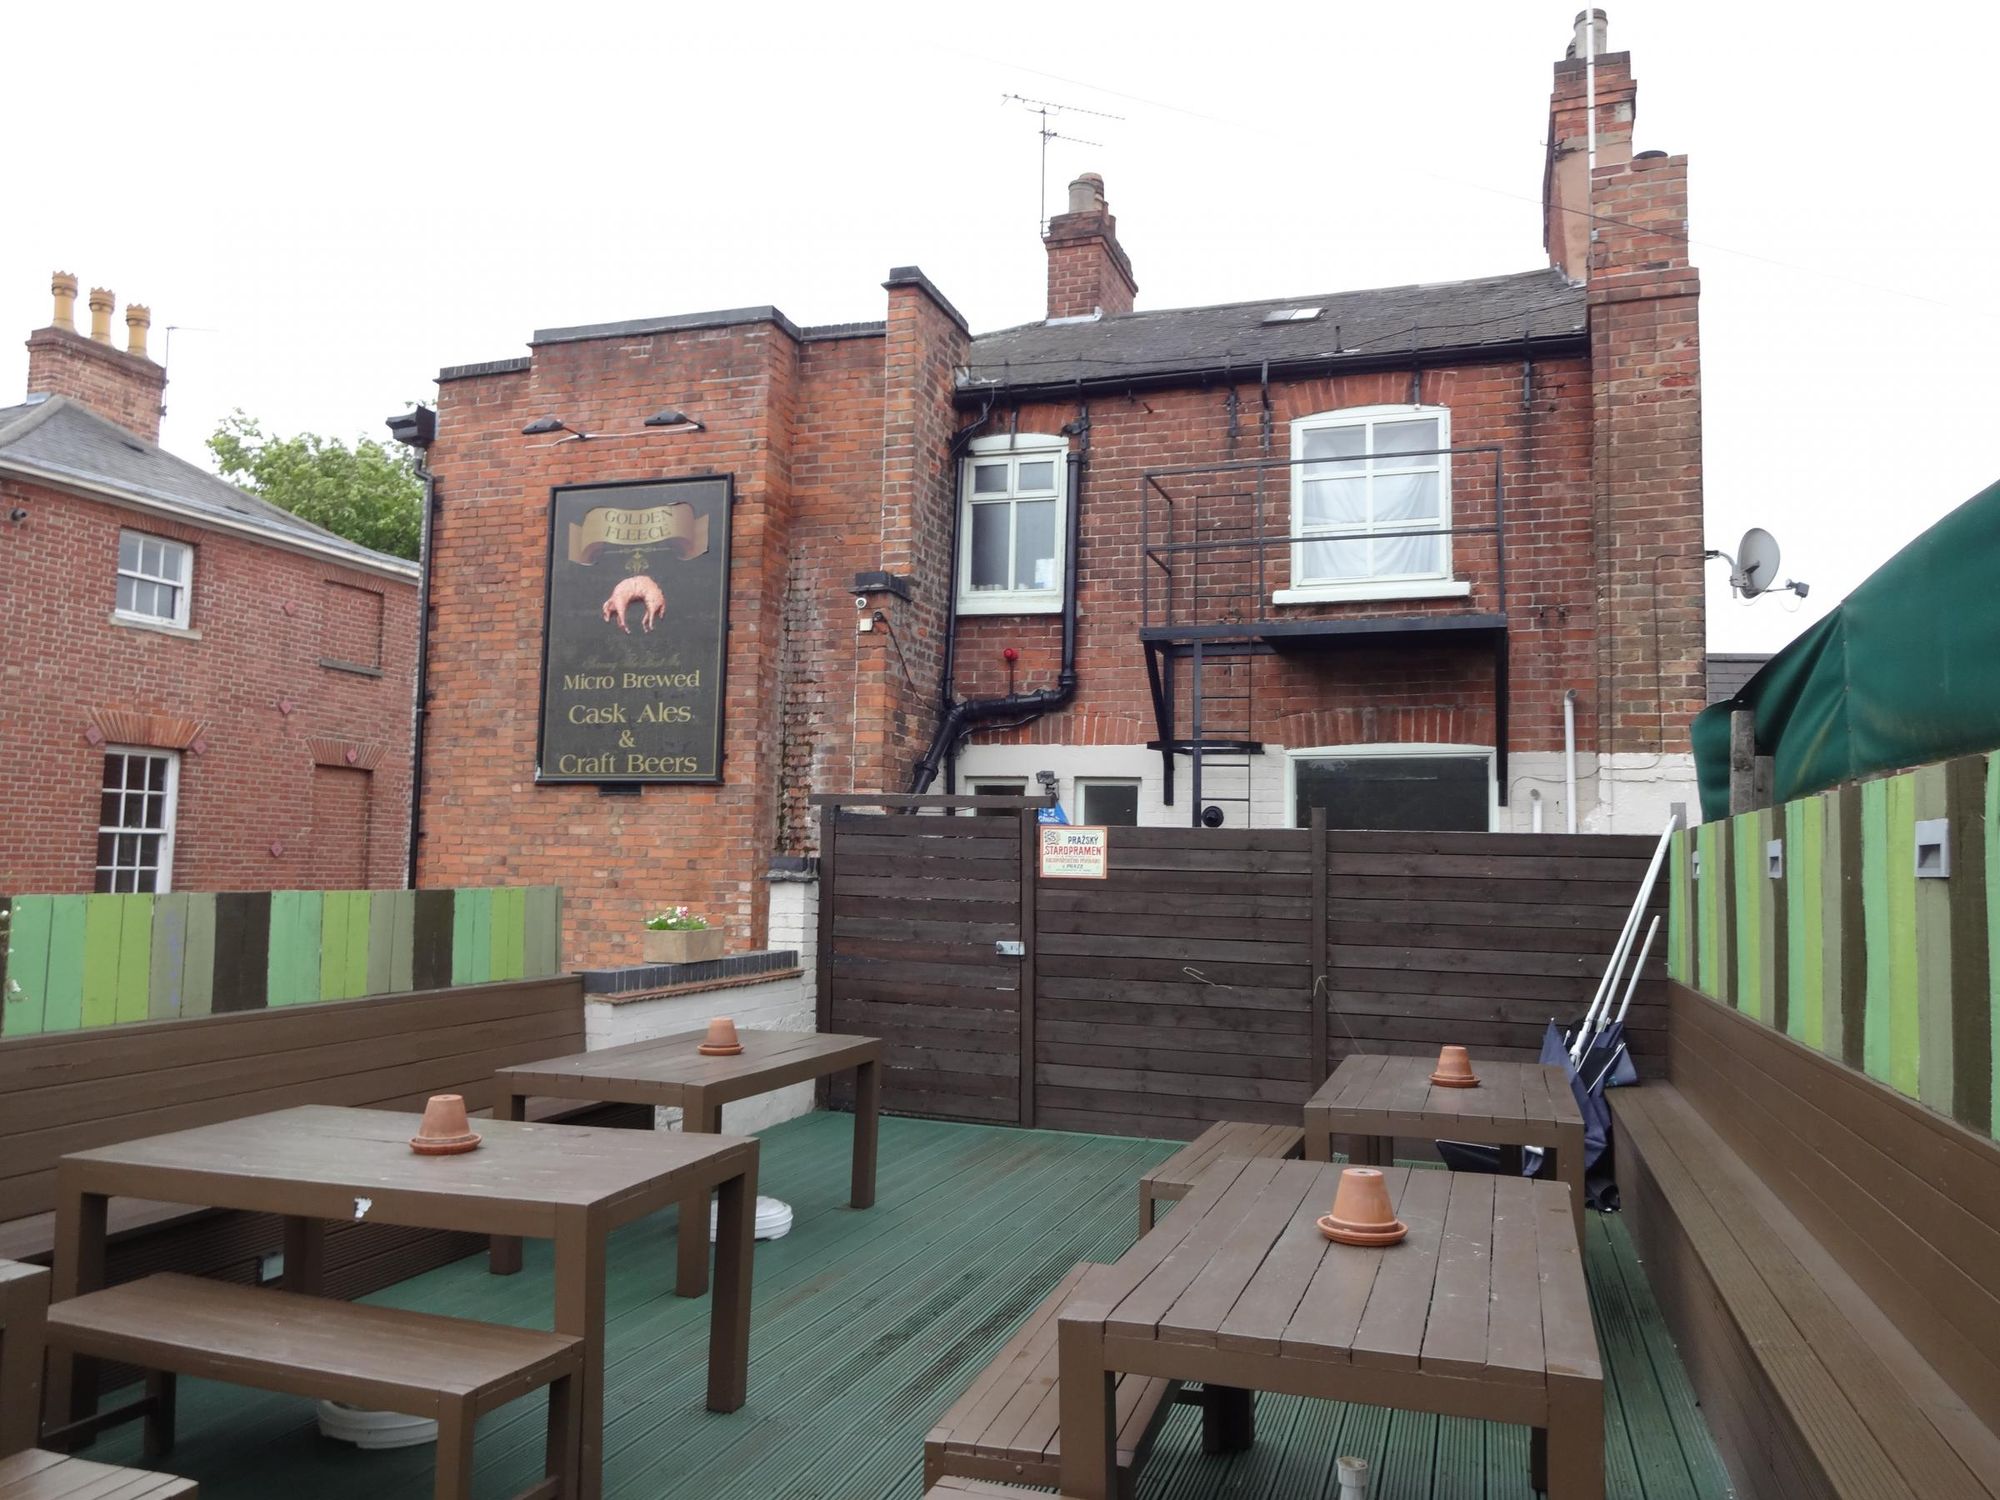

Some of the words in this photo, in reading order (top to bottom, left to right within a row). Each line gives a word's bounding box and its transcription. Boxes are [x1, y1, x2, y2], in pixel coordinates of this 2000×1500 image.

[605, 509, 672, 526] GOLDEN
[605, 523, 671, 540] FLEECE
[563, 673, 615, 690] Micro
[623, 670, 700, 688] Brewed
[568, 703, 626, 724] Cask
[637, 702, 691, 723] Ales
[618, 729, 636, 748] &
[559, 752, 616, 774] Craft
[627, 754, 697, 773] Beers
[1045, 846, 1101, 856] STAROPRAMEN
